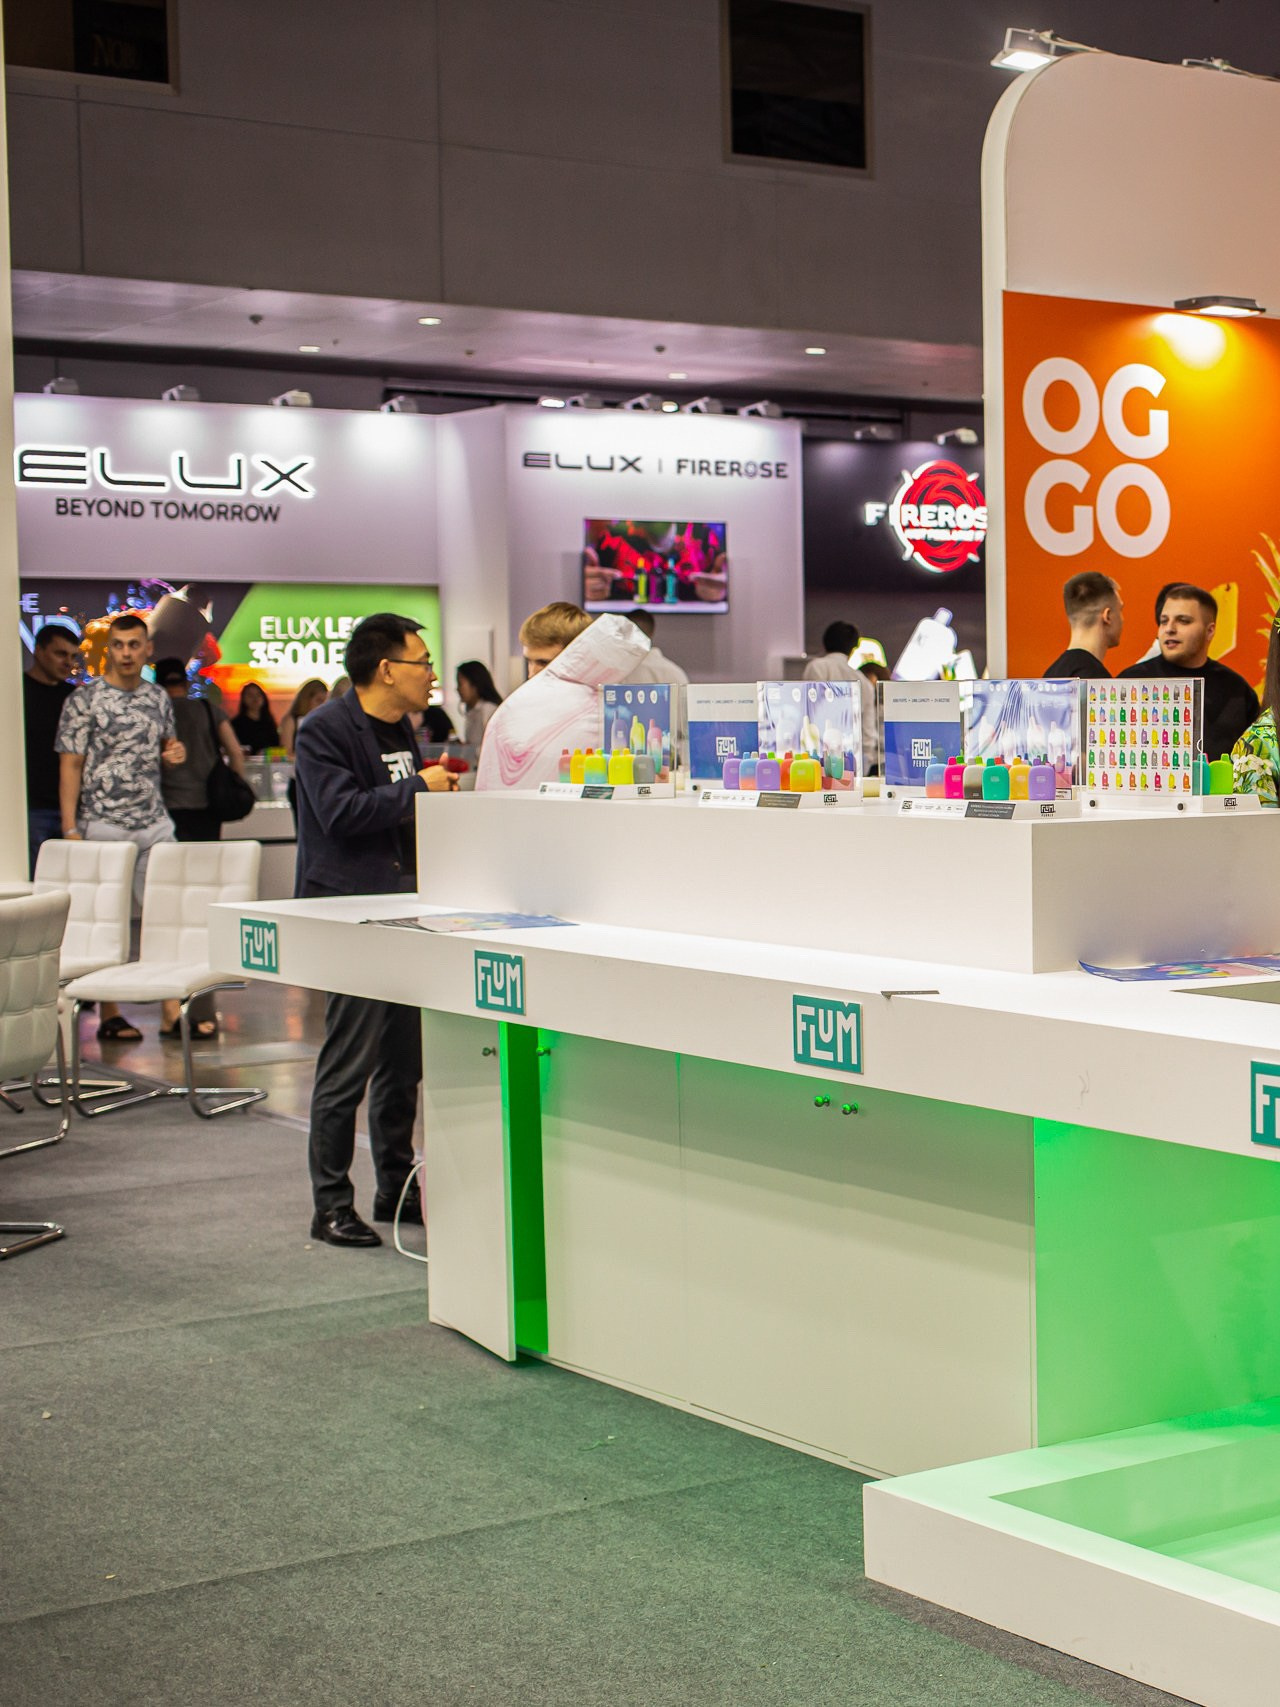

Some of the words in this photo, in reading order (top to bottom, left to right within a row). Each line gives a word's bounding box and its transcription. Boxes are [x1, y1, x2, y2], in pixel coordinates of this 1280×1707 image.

[1022, 357, 1170, 460] OG
[17, 447, 312, 496] ELUX
[522, 452, 643, 474] ELUX
[676, 458, 789, 479] FIREROSE
[55, 498, 145, 518] BEYOND
[150, 501, 281, 522] TOMORROW
[1023, 459, 1171, 559] GO
[260, 615, 321, 640] ELUX
[241, 923, 277, 969] FLUM
[476, 957, 522, 1010] FLUM
[796, 1003, 858, 1066] FLUM
